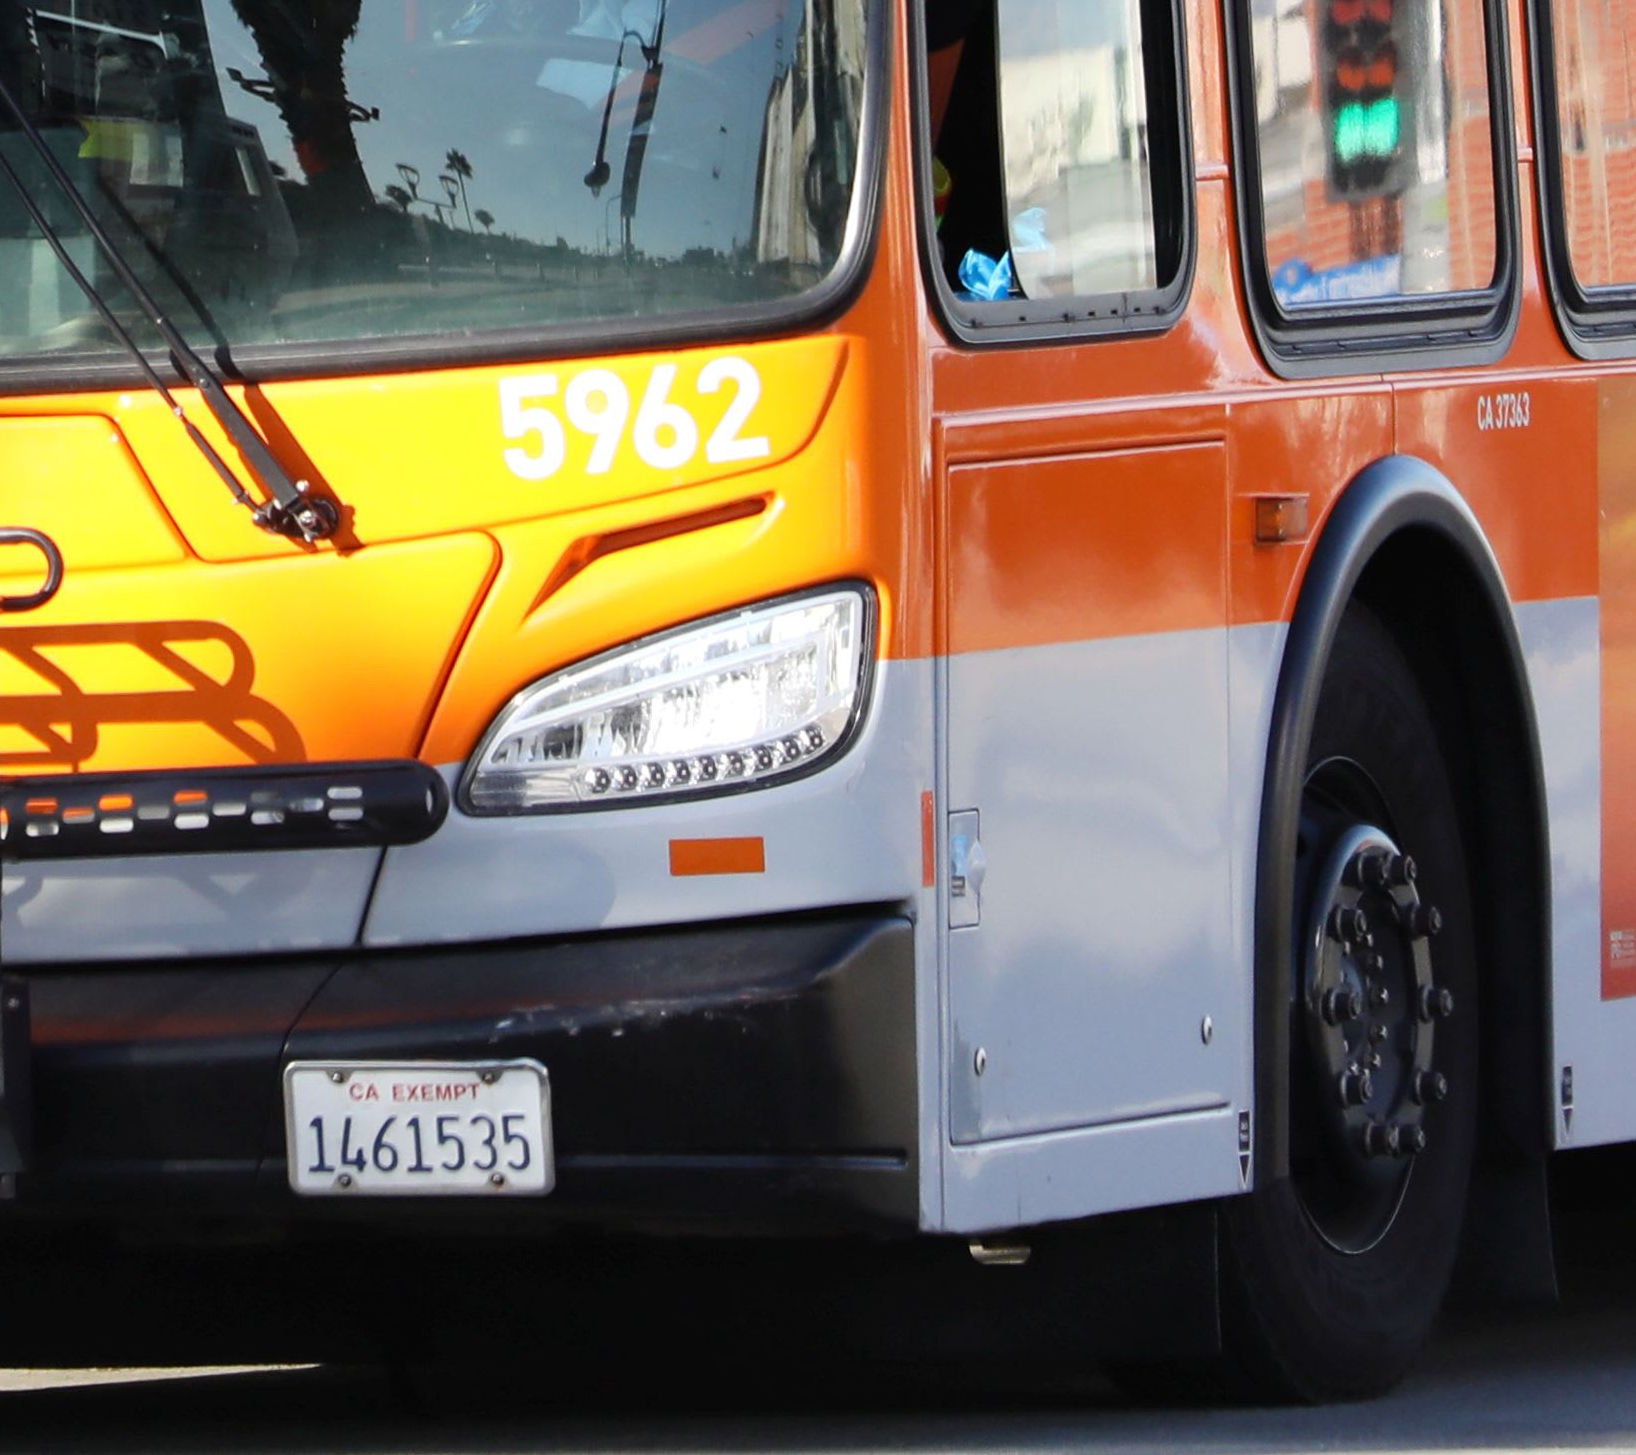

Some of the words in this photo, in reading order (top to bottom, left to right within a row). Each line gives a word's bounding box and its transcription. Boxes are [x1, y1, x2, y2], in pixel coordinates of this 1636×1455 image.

[498, 355, 772, 482] 5962
[1477, 394, 1494, 431] CA
[1494, 391, 1531, 429] 37363
[349, 1082, 380, 1102] CA
[392, 1082, 481, 1102] EXEMPT
[308, 1114, 531, 1174] 1461535
